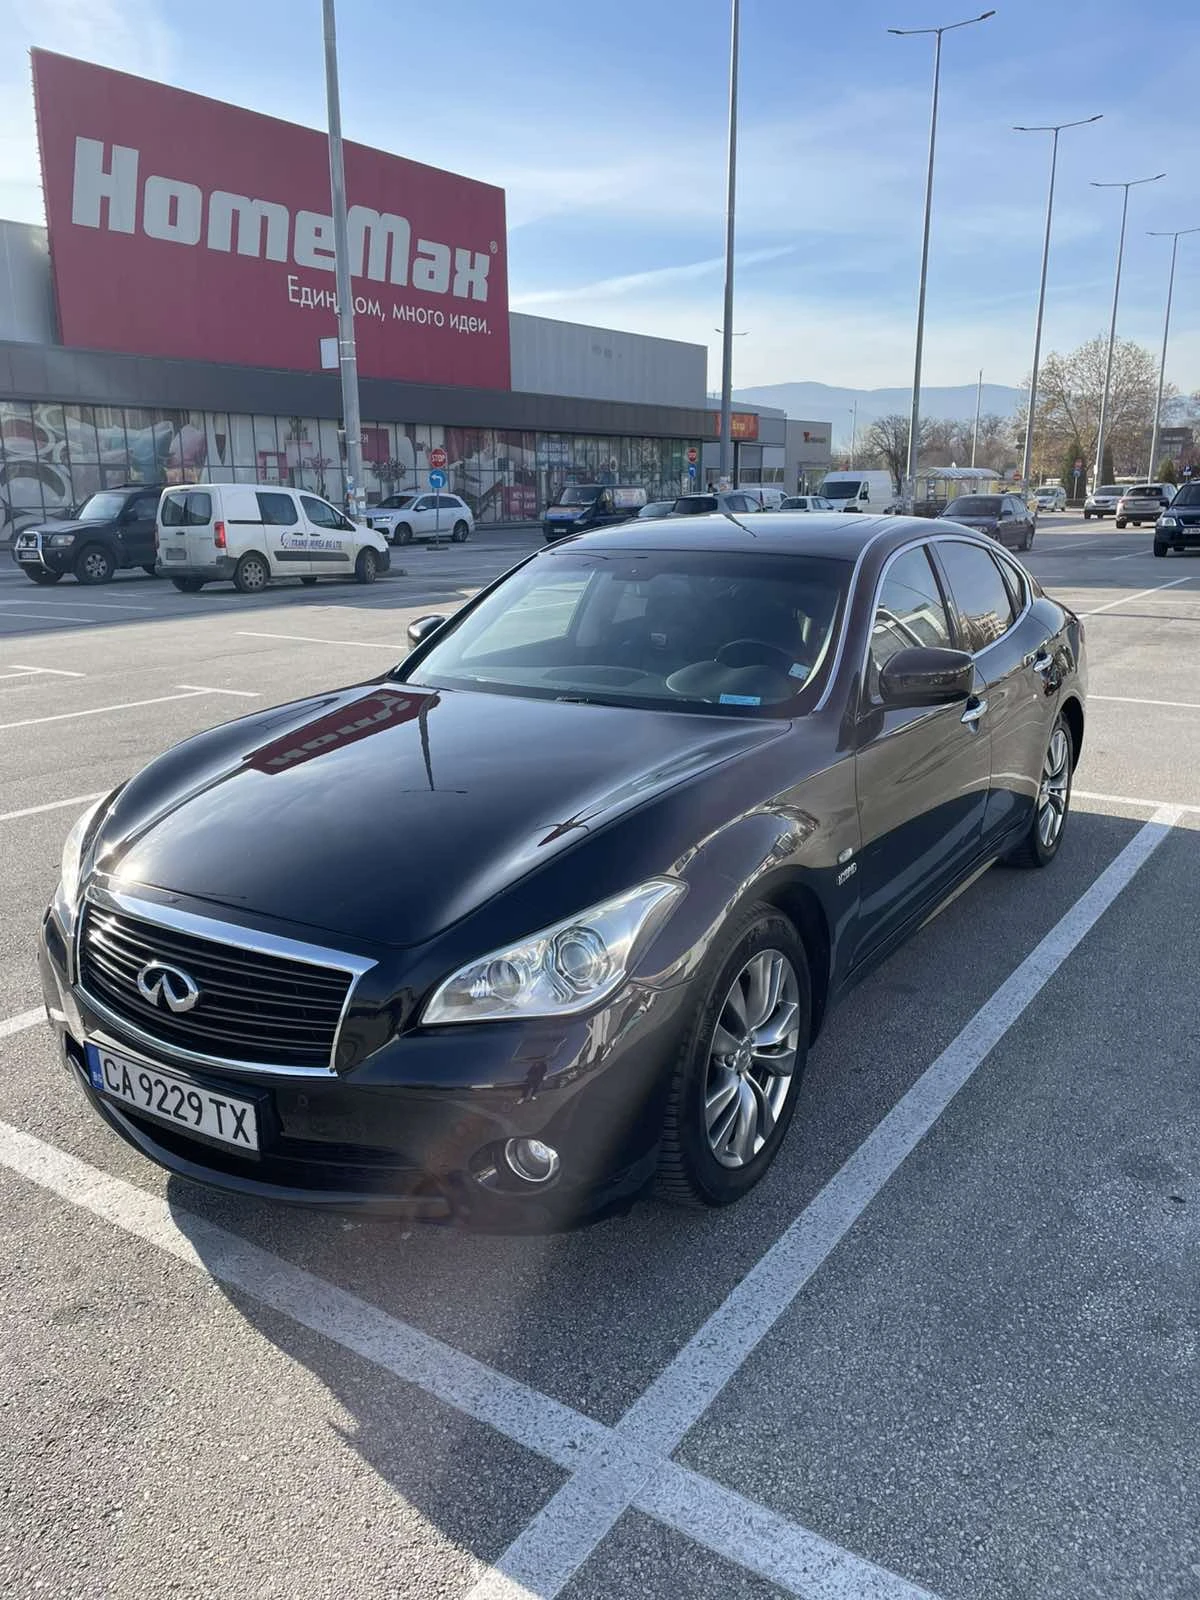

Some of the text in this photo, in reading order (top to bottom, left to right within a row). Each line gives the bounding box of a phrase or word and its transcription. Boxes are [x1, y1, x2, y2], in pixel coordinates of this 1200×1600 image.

[71, 136, 490, 301] HomeMax
[287, 274, 337, 309] Един
[393, 303, 445, 327] много
[449, 312, 492, 335] идеи.
[431, 454, 445, 463] STOP
[103, 1058, 251, 1144] CA 9229 TX
